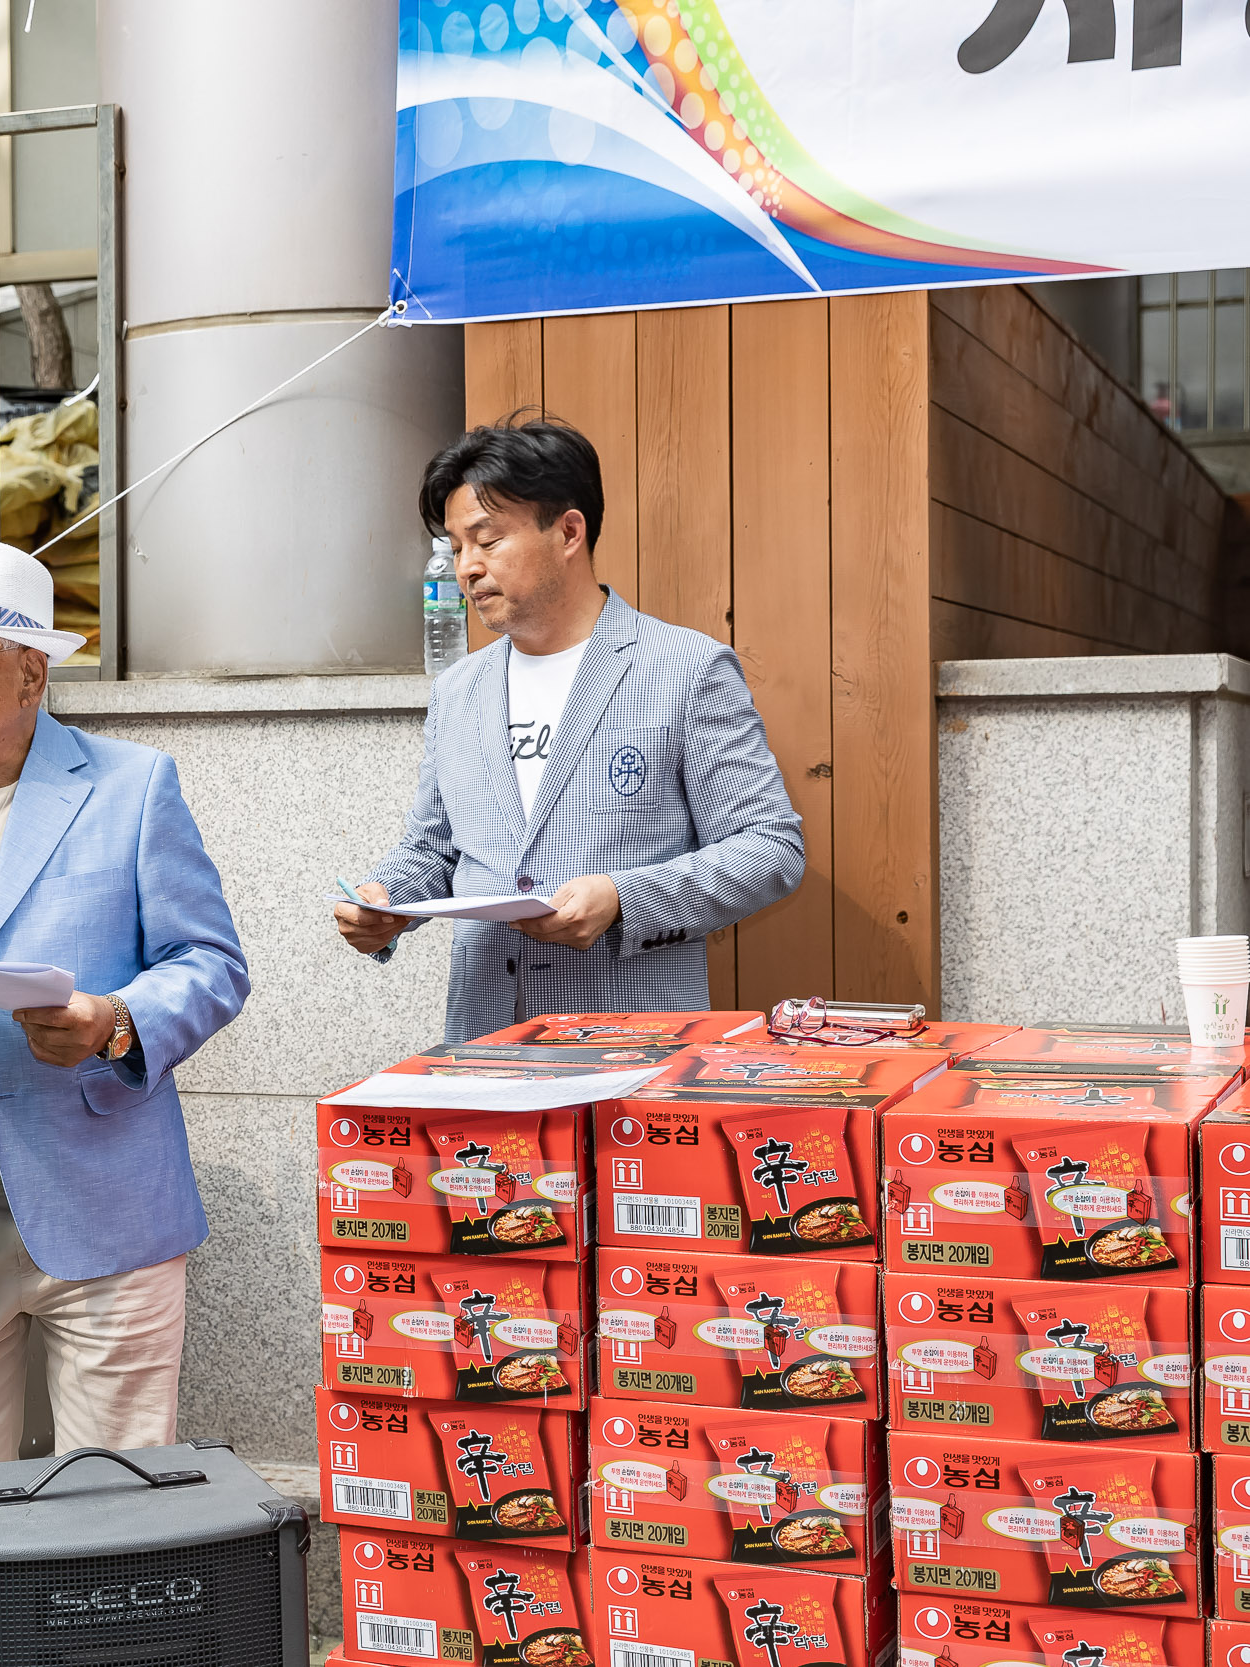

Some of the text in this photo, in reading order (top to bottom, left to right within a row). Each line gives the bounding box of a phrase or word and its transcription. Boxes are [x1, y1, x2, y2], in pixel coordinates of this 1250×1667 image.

[362, 1114, 410, 1125] 인생을 맛있게
[646, 1113, 699, 1124] 인생을 맛있게
[362, 1126, 411, 1146] 농심
[646, 1124, 699, 1145] 농심
[937, 1129, 994, 1139] 인생을 맛있게
[937, 1140, 994, 1163] 농심
[351, 1169, 369, 1177] 손잡이를
[371, 1170, 388, 1178] 이용하여
[752, 1137, 809, 1214] 辛
[803, 1170, 838, 1186] 라면
[449, 1184, 467, 1192] 편리하게
[955, 1190, 976, 1198] 손잡이를
[978, 1191, 999, 1199] 이용하여
[617, 1195, 642, 1203] 신라면(S)
[664, 1198, 697, 1206] 101003485
[954, 1198, 975, 1206] 편리하게
[1063, 1195, 1121, 1204] 투명 손잡이를 이용하여
[706, 1206, 739, 1222] 봉지면
[1073, 1204, 1094, 1212] 편리하게
[336, 1220, 407, 1240] 봉지면 20개입
[630, 1225, 684, 1234] 8801043014854
[707, 1223, 739, 1238] 20개입
[1225, 1228, 1250, 1237] 신라면(S
[907, 1243, 988, 1264] 봉지면 20개입
[367, 1261, 416, 1272] 인생을 맛있게
[646, 1262, 697, 1275] 인생을 맛있게
[367, 1273, 416, 1294] 농심
[646, 1275, 698, 1296] 농심
[937, 1288, 994, 1300] 인생을 맛있게
[937, 1300, 994, 1324] 농심
[511, 1334, 529, 1342] 편리하게
[533, 1328, 552, 1336] 이용하여
[717, 1326, 737, 1335] 손잡이를
[740, 1328, 759, 1336] 이용하여
[912, 1348, 968, 1359] 투명 손잡이를 이용하여
[922, 1357, 943, 1365] 편리하게
[341, 1365, 412, 1386] 봉지면 20개입
[617, 1370, 693, 1393] 봉지면 20개입
[361, 1400, 407, 1412] 인생을 맛있게
[907, 1401, 990, 1424] 봉지면 20개입
[361, 1414, 408, 1433] 농심
[638, 1414, 689, 1427] 인생을 맛있게
[638, 1425, 689, 1449] 농심
[456, 1430, 507, 1501] 辛
[943, 1453, 1000, 1467] 인생을 맛있게
[502, 1462, 534, 1477] 라면
[622, 1469, 640, 1477] 손잡이를
[642, 1471, 661, 1480] 이용하여
[620, 1476, 638, 1485] 편리하게
[943, 1466, 1000, 1489] 농심
[416, 1491, 445, 1507] 봉지면
[417, 1506, 446, 1523] 20개입
[610, 1521, 685, 1544] 봉지면 20개입
[1120, 1526, 1179, 1537] 투명 손잡이를 이용하여
[386, 1539, 434, 1551] 인생을 맛있게
[1130, 1535, 1152, 1544] 편리하게
[386, 1550, 434, 1572] 농심
[641, 1564, 692, 1578] 인생을 맛있게
[912, 1565, 996, 1589] 봉지면 20개입
[641, 1575, 692, 1600] 농심
[50, 1578, 201, 1613] SECO
[483, 1569, 535, 1641] 辛
[529, 1601, 562, 1616] 라면
[953, 1604, 1010, 1619] 인생을 맛있게
[441, 1629, 472, 1645] 봉지면
[954, 1617, 1010, 1642] 농심
[793, 1635, 828, 1650] 라면
[443, 1645, 473, 1661] 20개입
